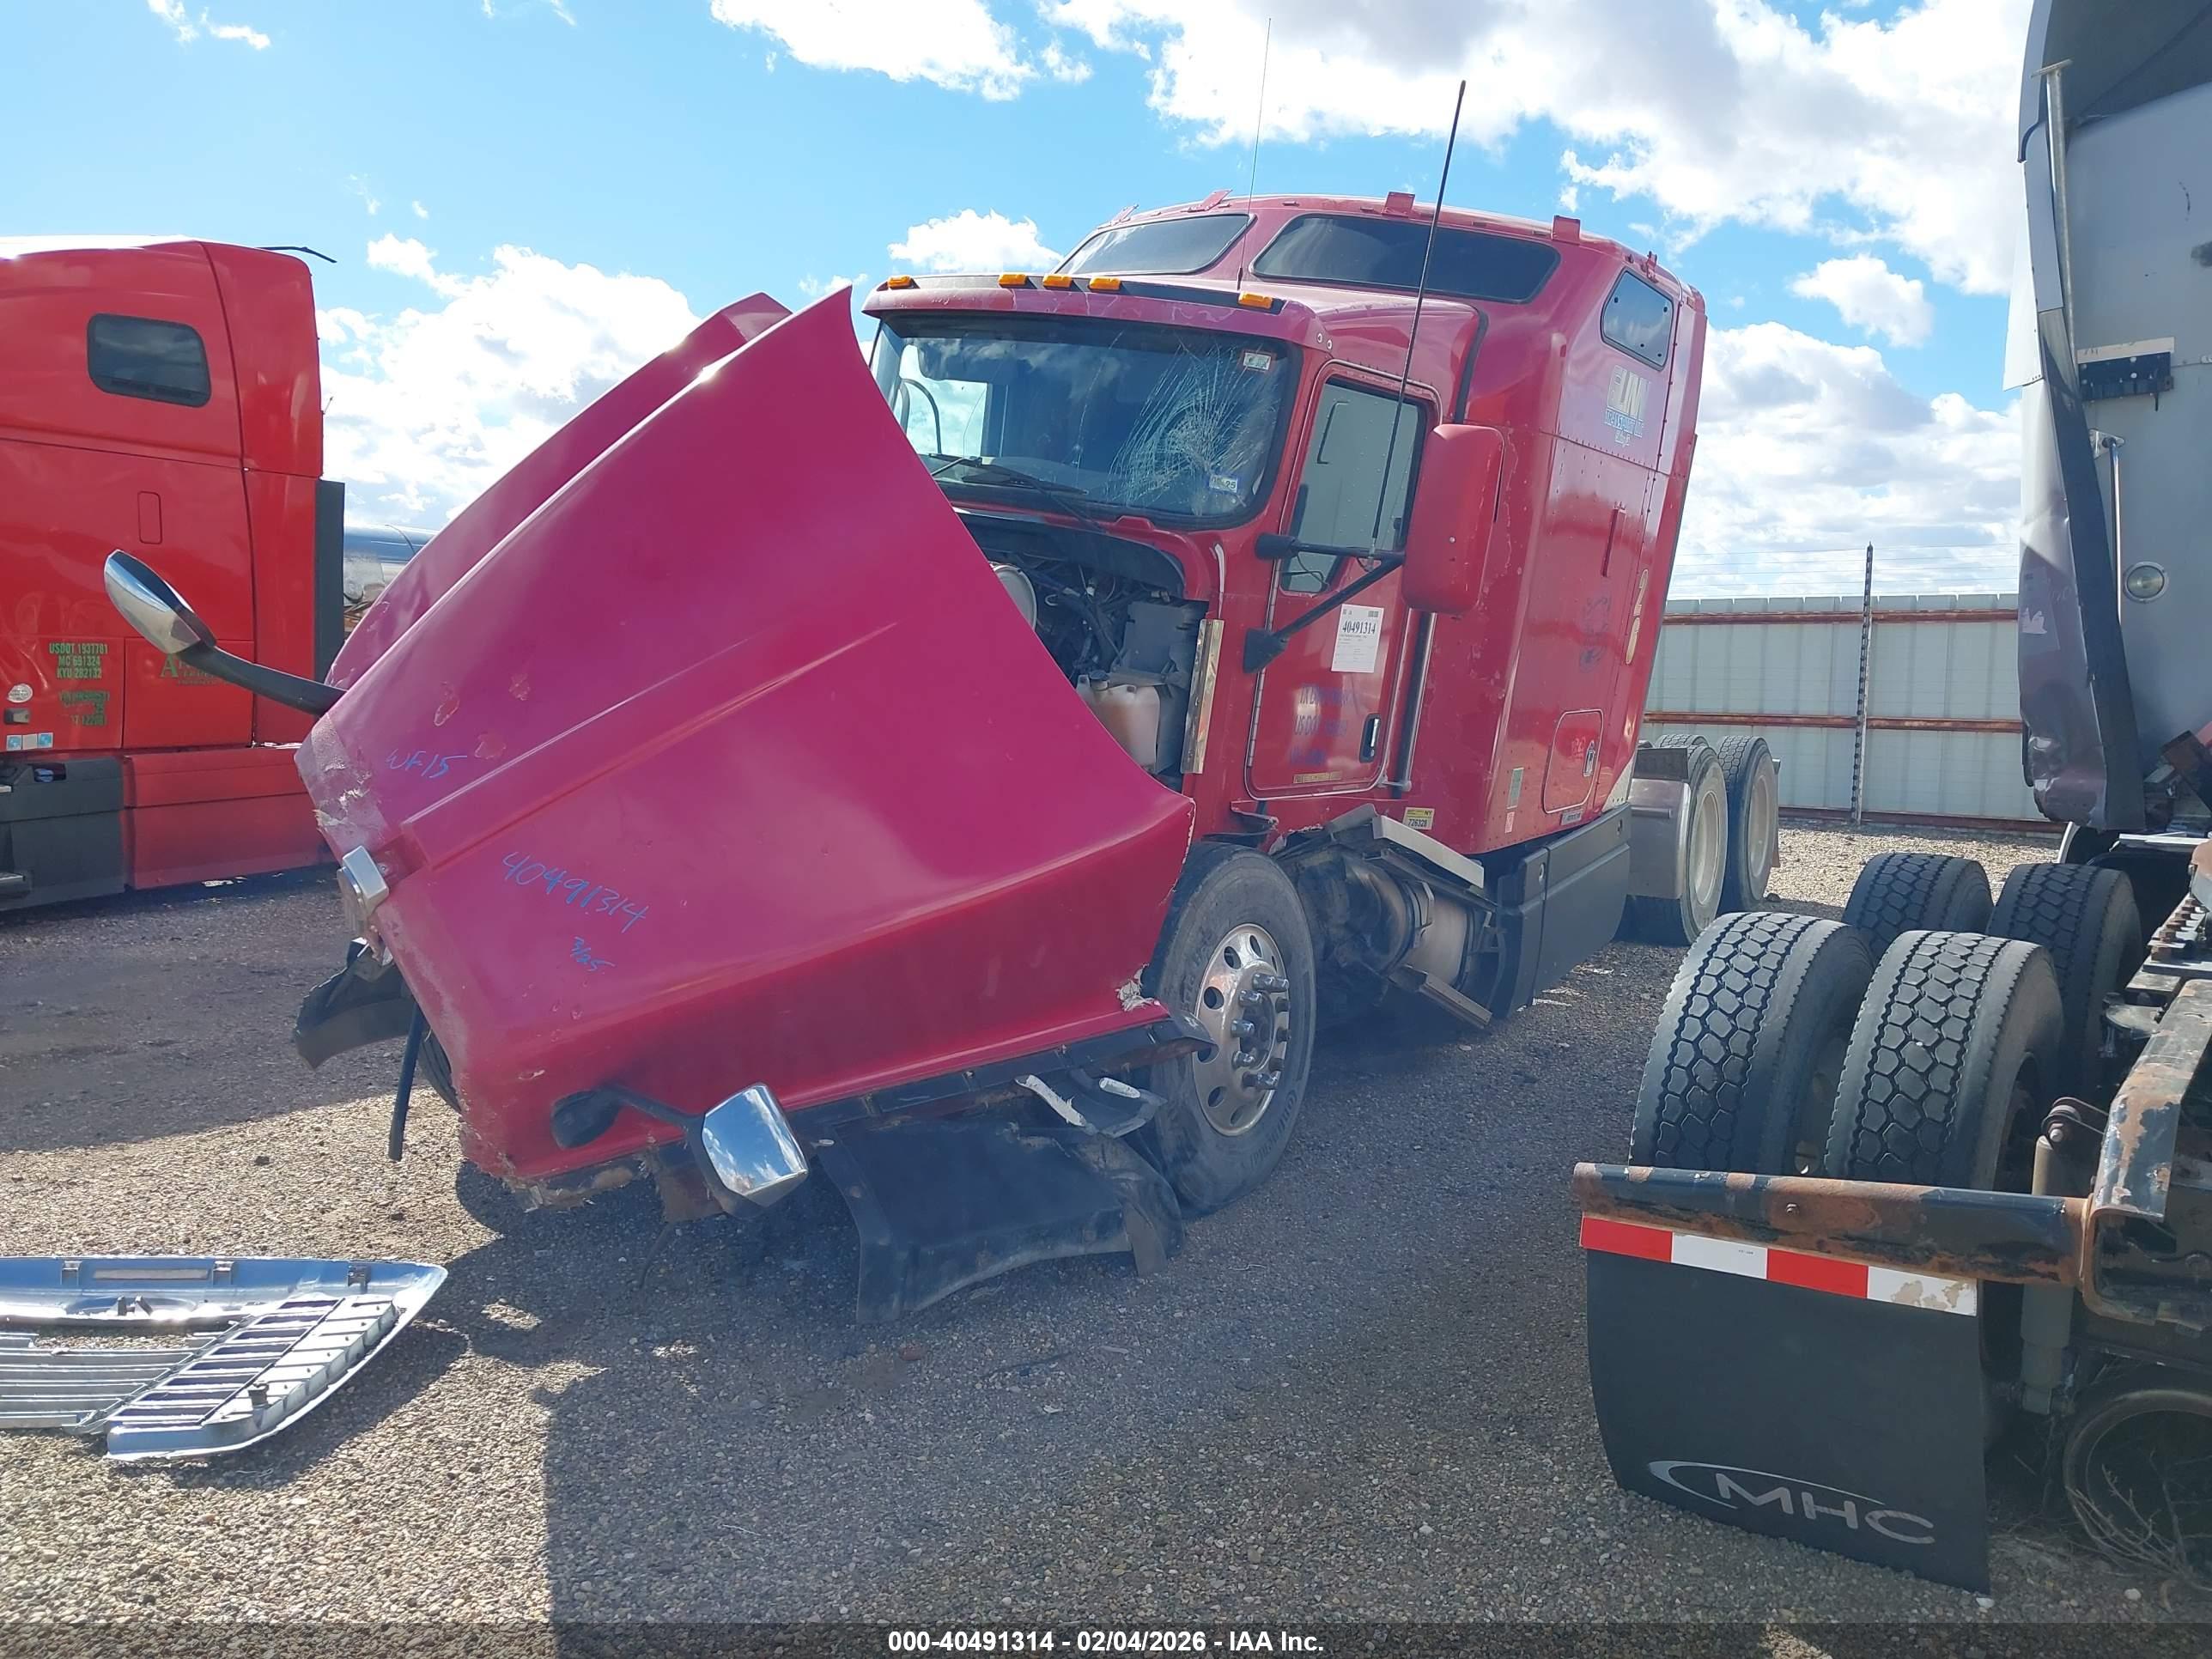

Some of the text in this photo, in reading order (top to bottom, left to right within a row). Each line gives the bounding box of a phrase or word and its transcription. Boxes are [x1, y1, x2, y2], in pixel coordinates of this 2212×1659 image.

[1342, 620, 1376, 634] 40491314
[49, 642, 76, 654] USDOT
[58, 655, 70, 666] MC
[502, 851, 649, 933] 40491314
[1716, 1473, 1935, 1544] MHC
